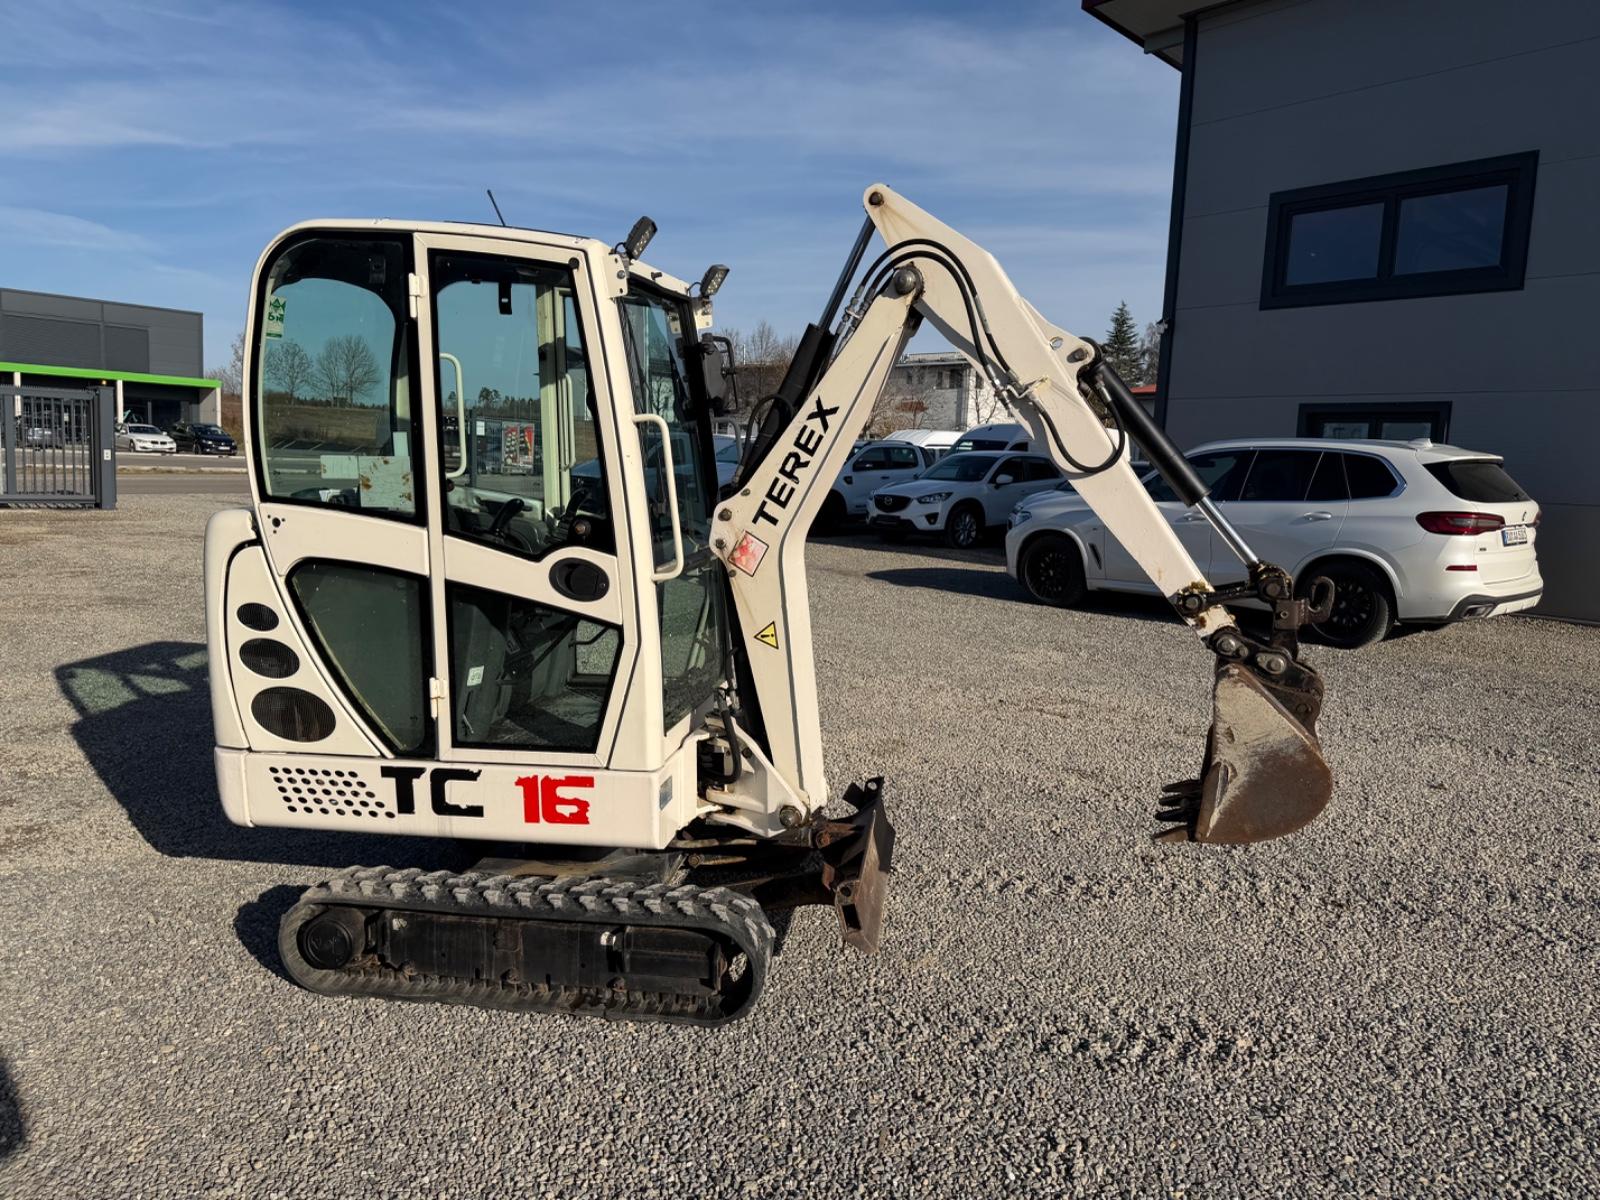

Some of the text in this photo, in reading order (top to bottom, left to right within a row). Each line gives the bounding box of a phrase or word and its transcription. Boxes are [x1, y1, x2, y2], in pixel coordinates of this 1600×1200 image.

[752, 395, 840, 526] TEREX
[380, 766, 595, 825] TC 16
